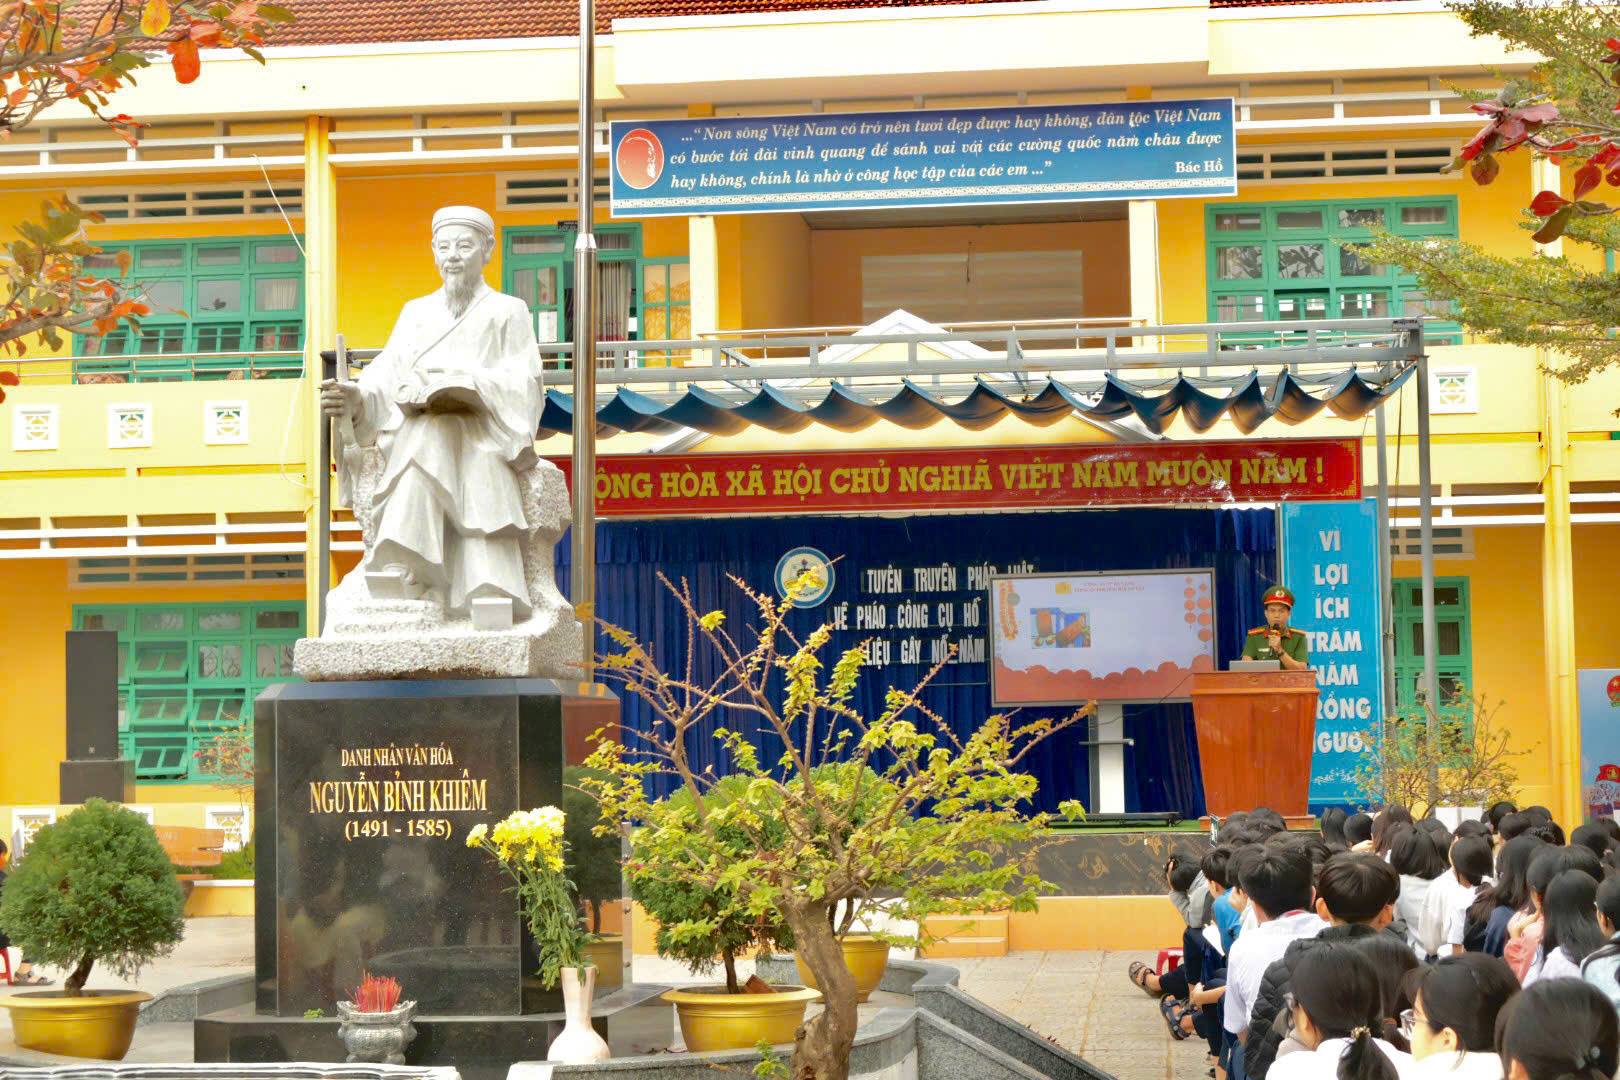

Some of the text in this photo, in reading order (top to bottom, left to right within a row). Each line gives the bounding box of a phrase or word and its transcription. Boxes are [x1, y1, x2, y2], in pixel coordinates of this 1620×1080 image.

[736, 127, 768, 141] sông
[772, 124, 800, 140] Việt
[803, 123, 837, 136] Nam
[841, 122, 856, 135] có
[885, 121, 911, 134] nên
[915, 118, 943, 132] tươi
[976, 116, 1010, 132] được
[1014, 114, 1040, 130] hay
[1129, 111, 1150, 127] tộc
[1154, 109, 1183, 125] Việt
[1186, 108, 1221, 121] Nam
[670, 151, 686, 164] có
[691, 150, 724, 164] bước
[729, 148, 749, 162] tới
[783, 145, 815, 159] vinh
[820, 146, 866, 161] quang
[893, 142, 928, 156] sánh
[934, 140, 956, 154] vai
[962, 140, 983, 154] với
[988, 139, 1013, 152] các
[1018, 138, 1062, 153] cường
[1067, 135, 1101, 152] quốc
[1107, 135, 1139, 148] năm
[1144, 132, 1181, 146] châu
[1186, 131, 1222, 147] được
[671, 175, 696, 190] hay
[700, 173, 747, 188] không,
[751, 171, 791, 185] chính
[795, 170, 810, 183] là
[813, 169, 842, 183] nhờ
[856, 168, 889, 184] công
[893, 166, 918, 182] học
[922, 166, 946, 182] tập
[949, 164, 976, 178] của
[979, 164, 1003, 177] các
[1007, 165, 1028, 176] em
[1175, 157, 1223, 173] Bác Hồ
[595, 467, 653, 505] ỘNG
[660, 464, 720, 498] HÒA
[726, 463, 767, 496] XÃ
[773, 462, 822, 501] HỘI
[829, 458, 891, 494] CHỦ
[1000, 456, 1065, 496] VIỆT
[1072, 460, 1139, 488] NAM
[1146, 453, 1233, 487] MUÔN
[1316, 457, 1323, 483] !
[867, 564, 903, 594] TUYÊN
[914, 562, 957, 592] TRUYỀN
[1314, 563, 1349, 590] LỢI
[898, 599, 928, 628] CÔNG
[938, 602, 953, 632] CỤ
[1315, 592, 1350, 619] ÍCH
[866, 636, 891, 670] LIỆU
[901, 636, 922, 665] GÂY
[959, 634, 985, 664] NĂM
[1305, 627, 1362, 653] TRĂM
[1309, 660, 1359, 686] NĂM
[341, 742, 454, 766] DANH NHÂN VĂN HÓA
[309, 768, 488, 813] NGUYỄN BỈNH KHIÊM
[345, 820, 389, 841] (1491
[407, 819, 452, 840] 1585)
